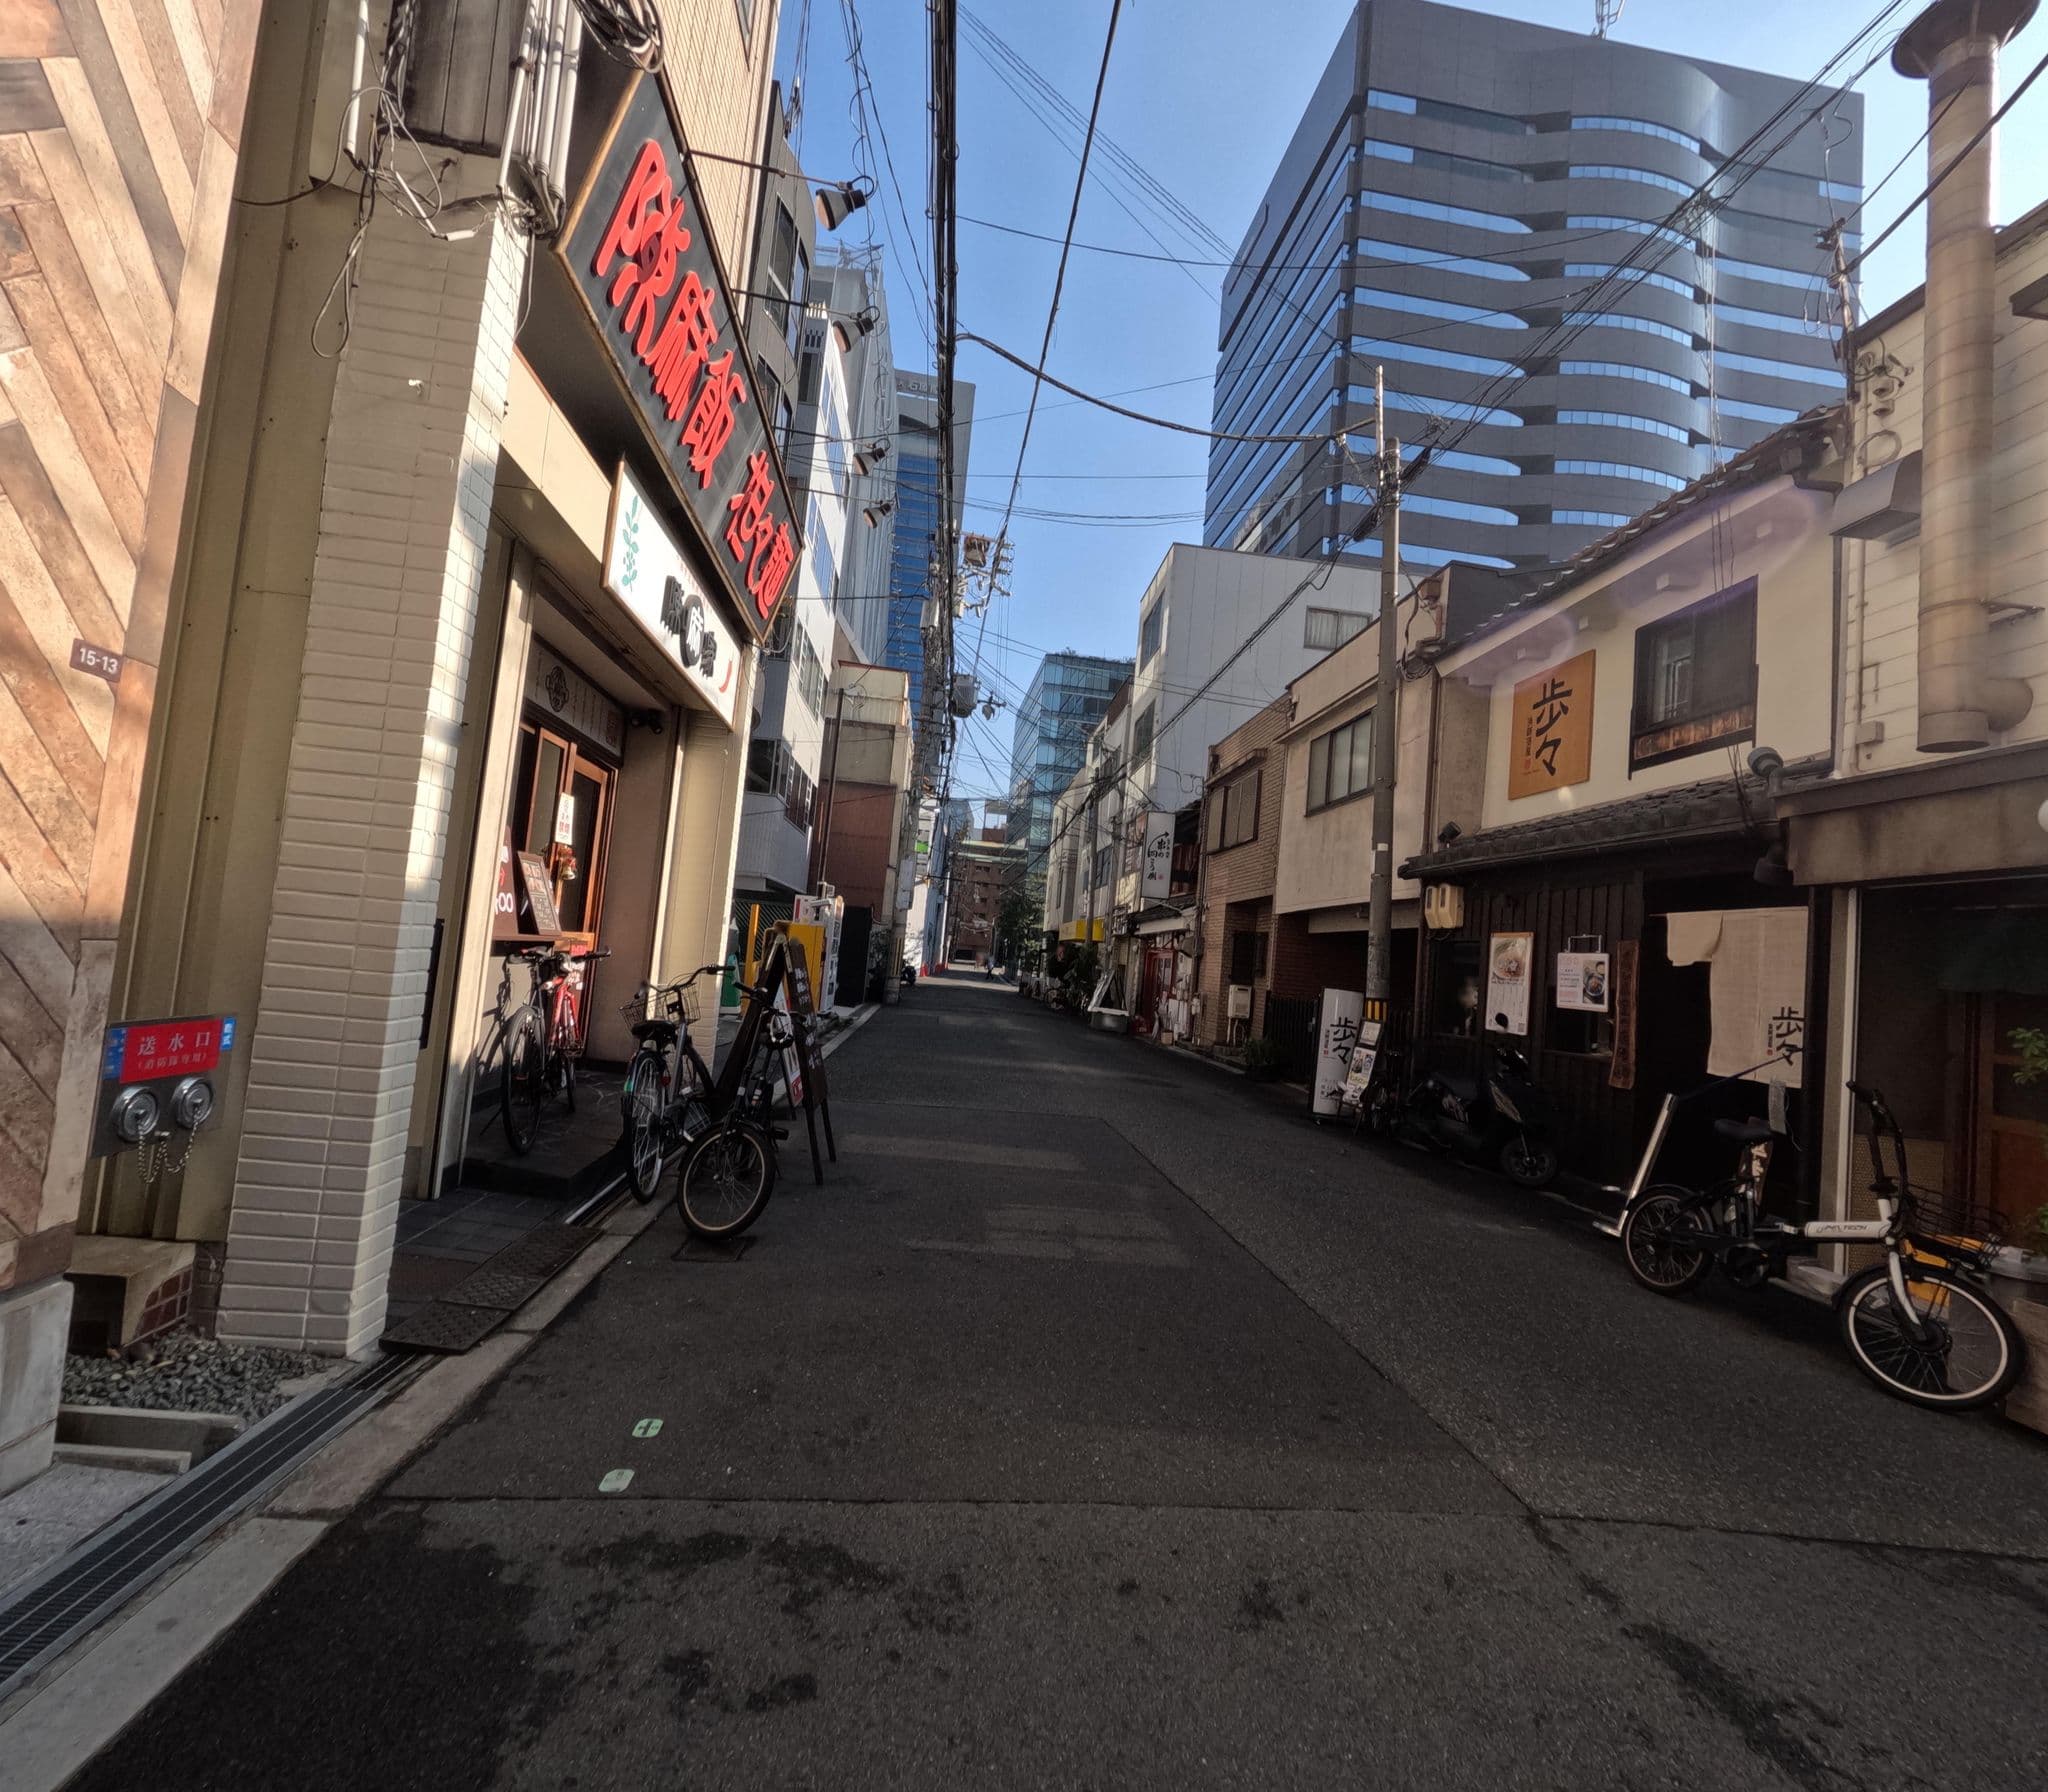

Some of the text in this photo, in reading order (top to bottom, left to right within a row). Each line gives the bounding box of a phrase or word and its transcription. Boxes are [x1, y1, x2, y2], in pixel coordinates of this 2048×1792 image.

[79, 647, 119, 674] 15-13
[1532, 678, 1573, 777] 歩々
[137, 1031, 211, 1056] 送水口
[1330, 1016, 1358, 1065] 歩々
[1772, 1006, 1806, 1067] 歩々
